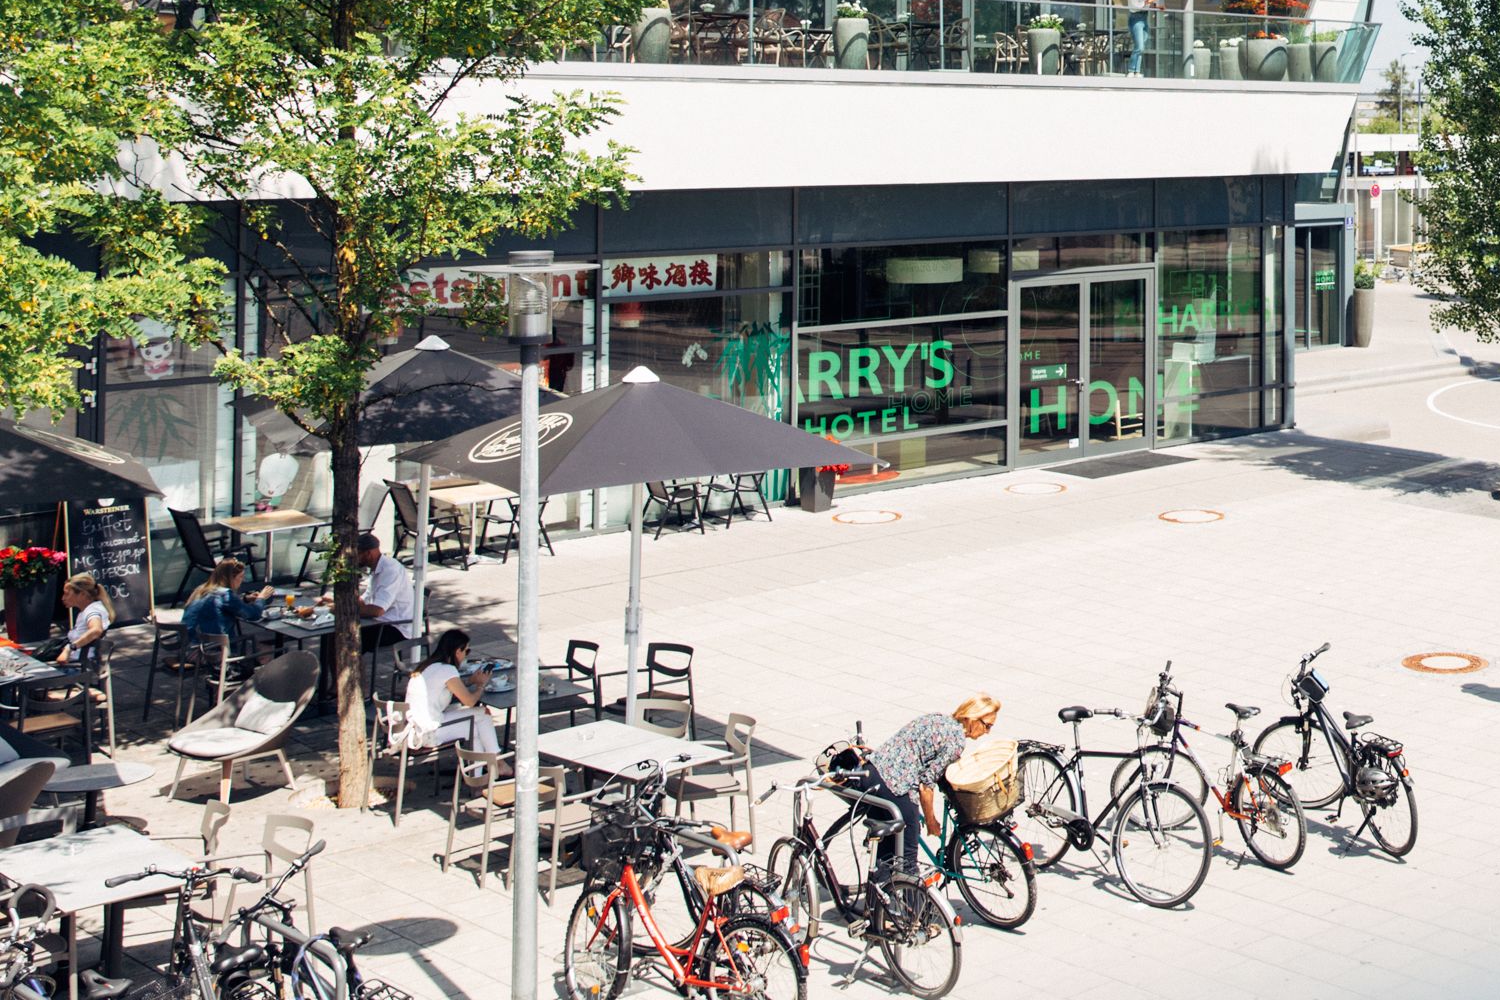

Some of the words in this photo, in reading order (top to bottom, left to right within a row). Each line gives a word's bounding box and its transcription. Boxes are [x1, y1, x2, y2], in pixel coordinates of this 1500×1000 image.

[798, 340, 955, 404] RRY'S
[805, 407, 919, 441] HOTEL
[81, 512, 132, 538] Buffet
